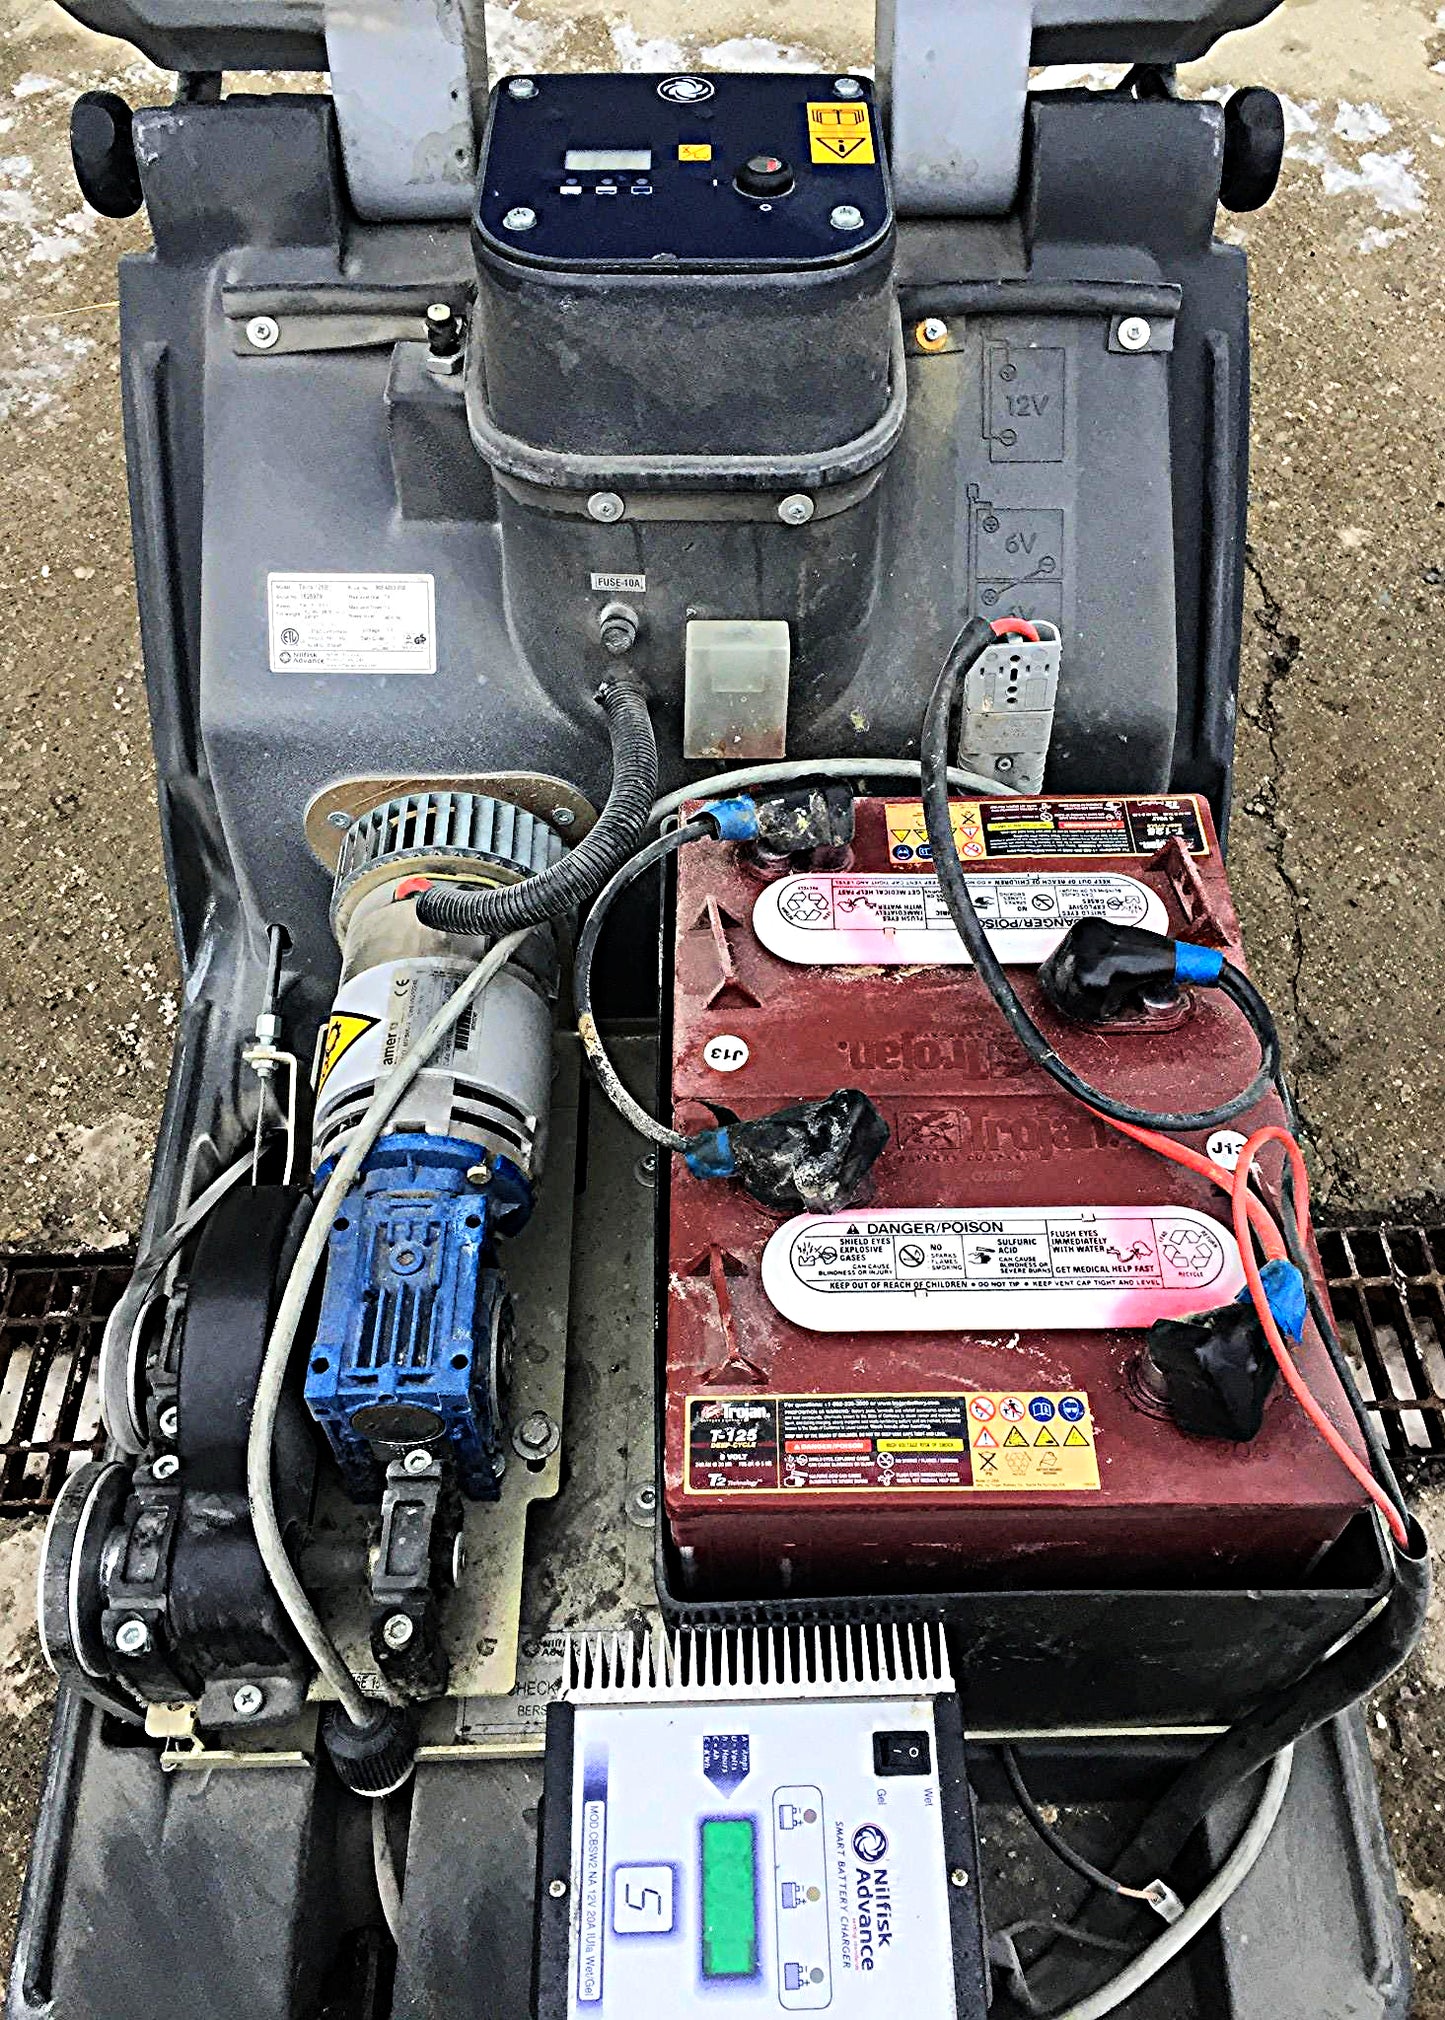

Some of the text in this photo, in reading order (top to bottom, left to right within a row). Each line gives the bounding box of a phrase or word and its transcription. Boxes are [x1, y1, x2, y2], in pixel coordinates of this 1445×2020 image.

[1004, 393, 1050, 417] 12V
[1004, 532, 1038, 555] 6V
[597, 577, 641, 588] FUSE-10A
[383, 1032, 397, 1066] amer
[710, 1047, 744, 1061] J13
[867, 1221, 1004, 1235] DANGER/POISON
[1050, 1229, 1099, 1238] FLUSH EYES
[840, 1237, 891, 1246] SHIELD EYES
[930, 1243, 943, 1251] NO
[997, 1238, 1037, 1246] SULFURIC
[1051, 1237, 1108, 1245] IMMEDIATELY
[840, 1246, 883, 1254] EXPLOSIVE
[1076, 1245, 1105, 1253] WATER
[840, 1254, 866, 1262] GASES
[1072, 1265, 1110, 1273] MEDICAL
[883, 1281, 911, 1289] REACH
[925, 1280, 968, 1288] CHILDREN
[721, 1402, 767, 1422] Trojan
[709, 1428, 758, 1442] T-125
[707, 1473, 727, 1487] T2
[876, 1788, 888, 1806] Gel
[923, 1787, 934, 1807] Wet
[587, 1871, 598, 1887] NA
[586, 1889, 597, 1908] 12V
[834, 1821, 852, 1969] SMART BATTERY CHARGER
[873, 1868, 893, 1948] Nilfisk
[586, 1910, 597, 1931] 20A
[855, 1867, 875, 1972] Advance
[584, 1955, 596, 1997] Wet/Gel
